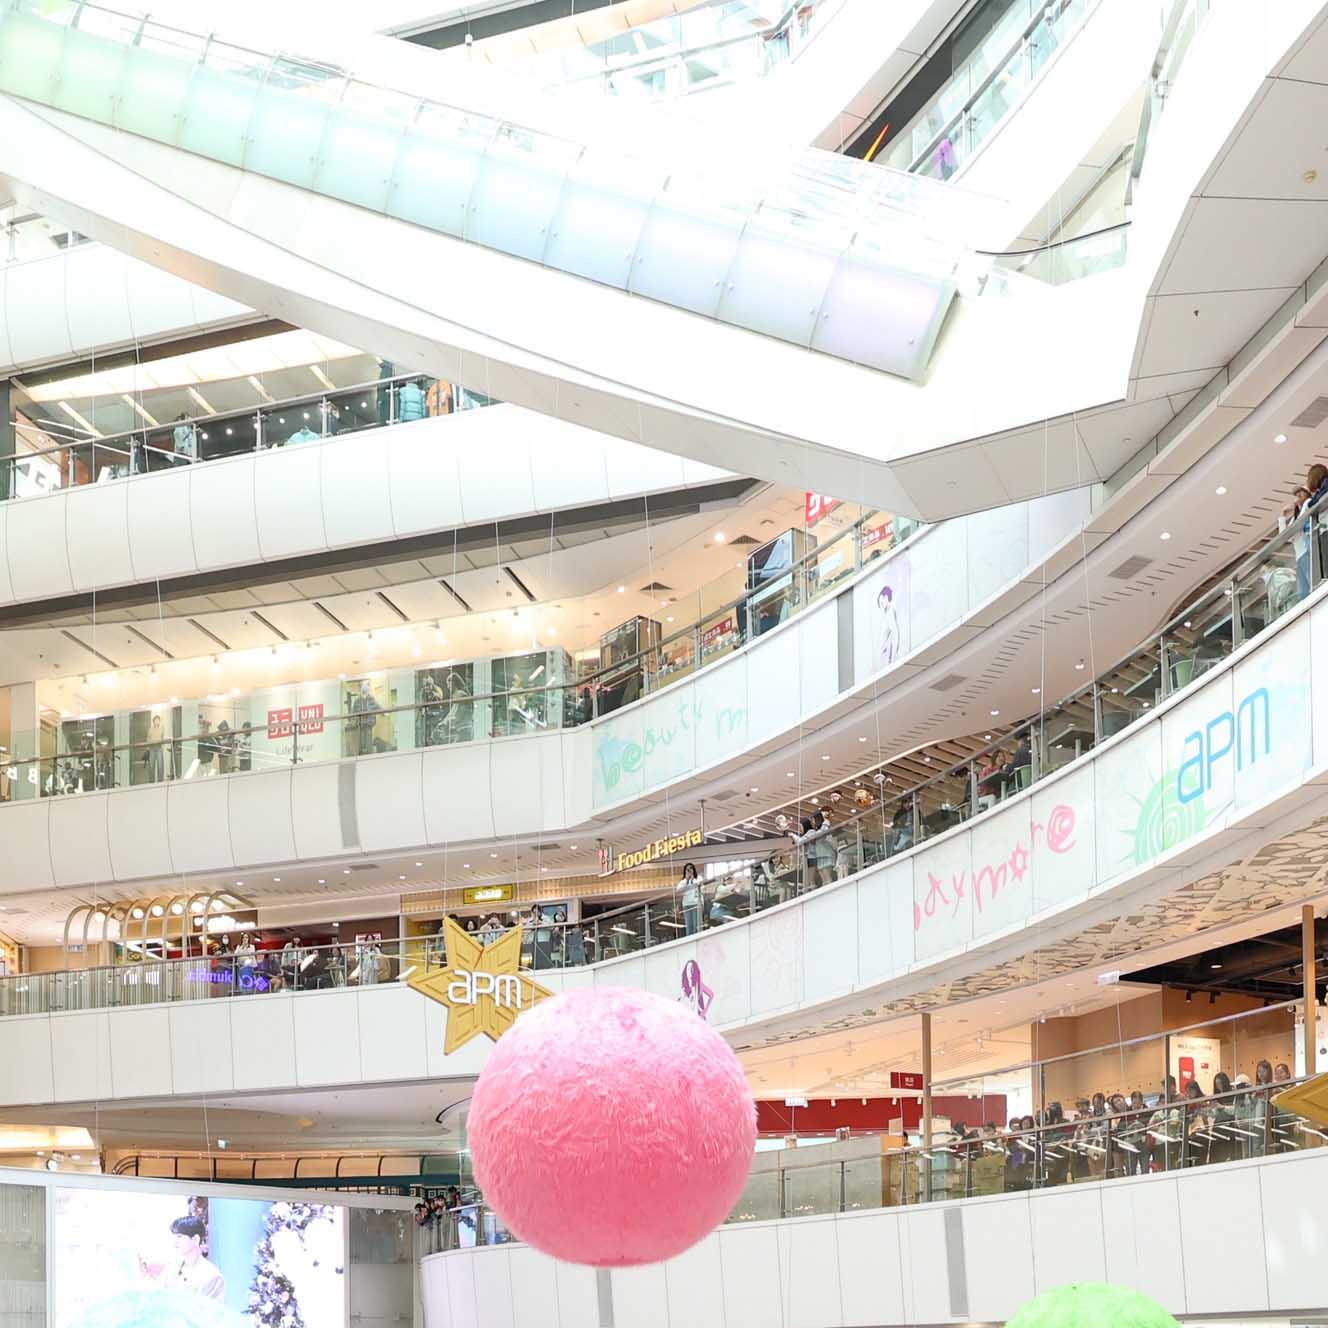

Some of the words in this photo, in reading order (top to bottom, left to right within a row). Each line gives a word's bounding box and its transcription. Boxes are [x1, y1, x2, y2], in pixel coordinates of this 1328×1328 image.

[1177, 686, 1271, 804] apm
[617, 844, 652, 871] Food
[653, 829, 702, 860] Fiesta
[447, 969, 522, 1009] apm
